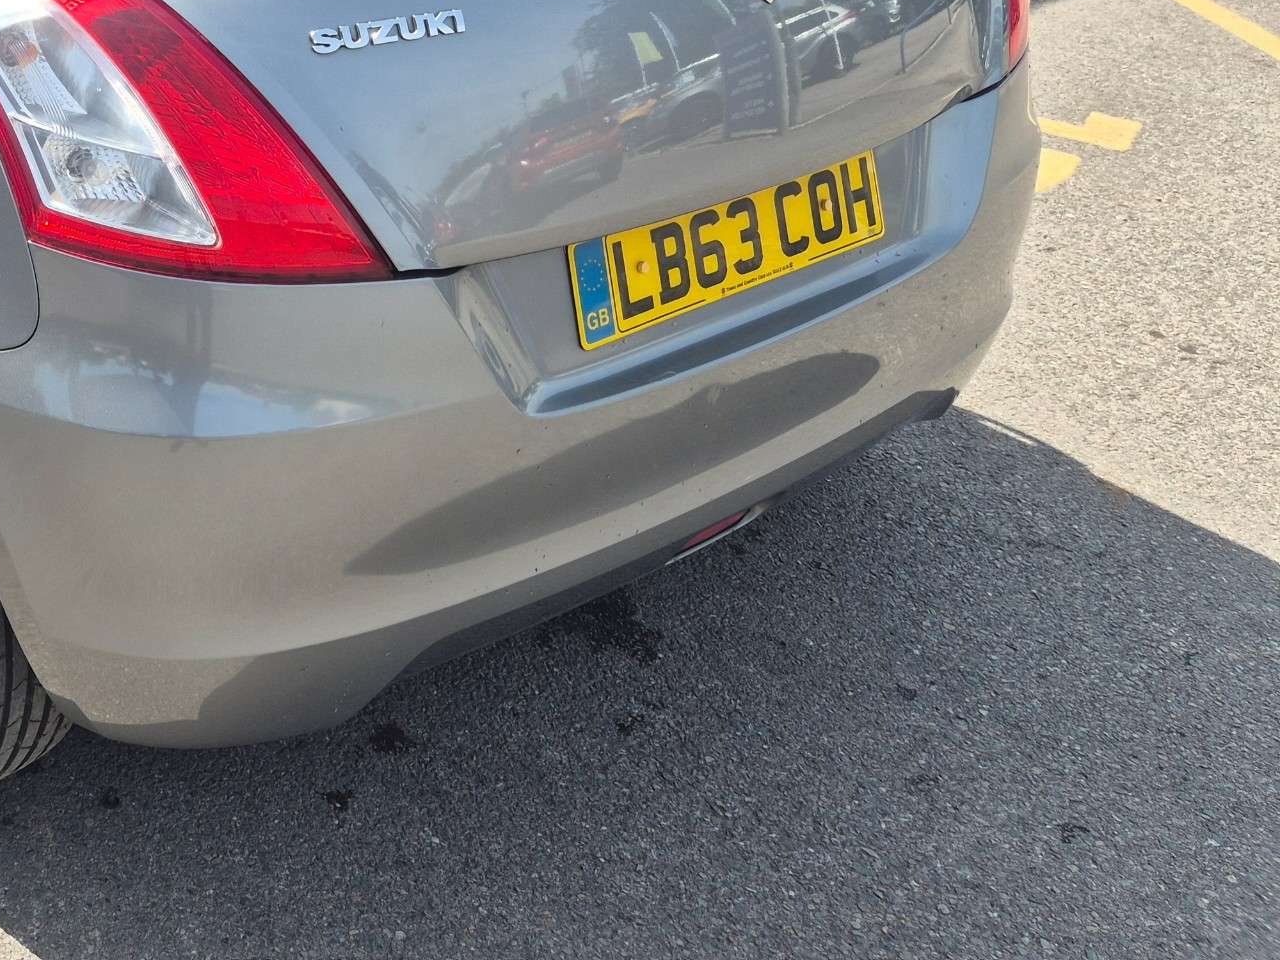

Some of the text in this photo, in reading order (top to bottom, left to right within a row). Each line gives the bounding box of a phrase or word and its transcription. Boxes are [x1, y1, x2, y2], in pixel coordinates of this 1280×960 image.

[309, 9, 466, 55] SUZUKI
[612, 156, 877, 321] LB63 COH
[586, 307, 611, 332] GB
